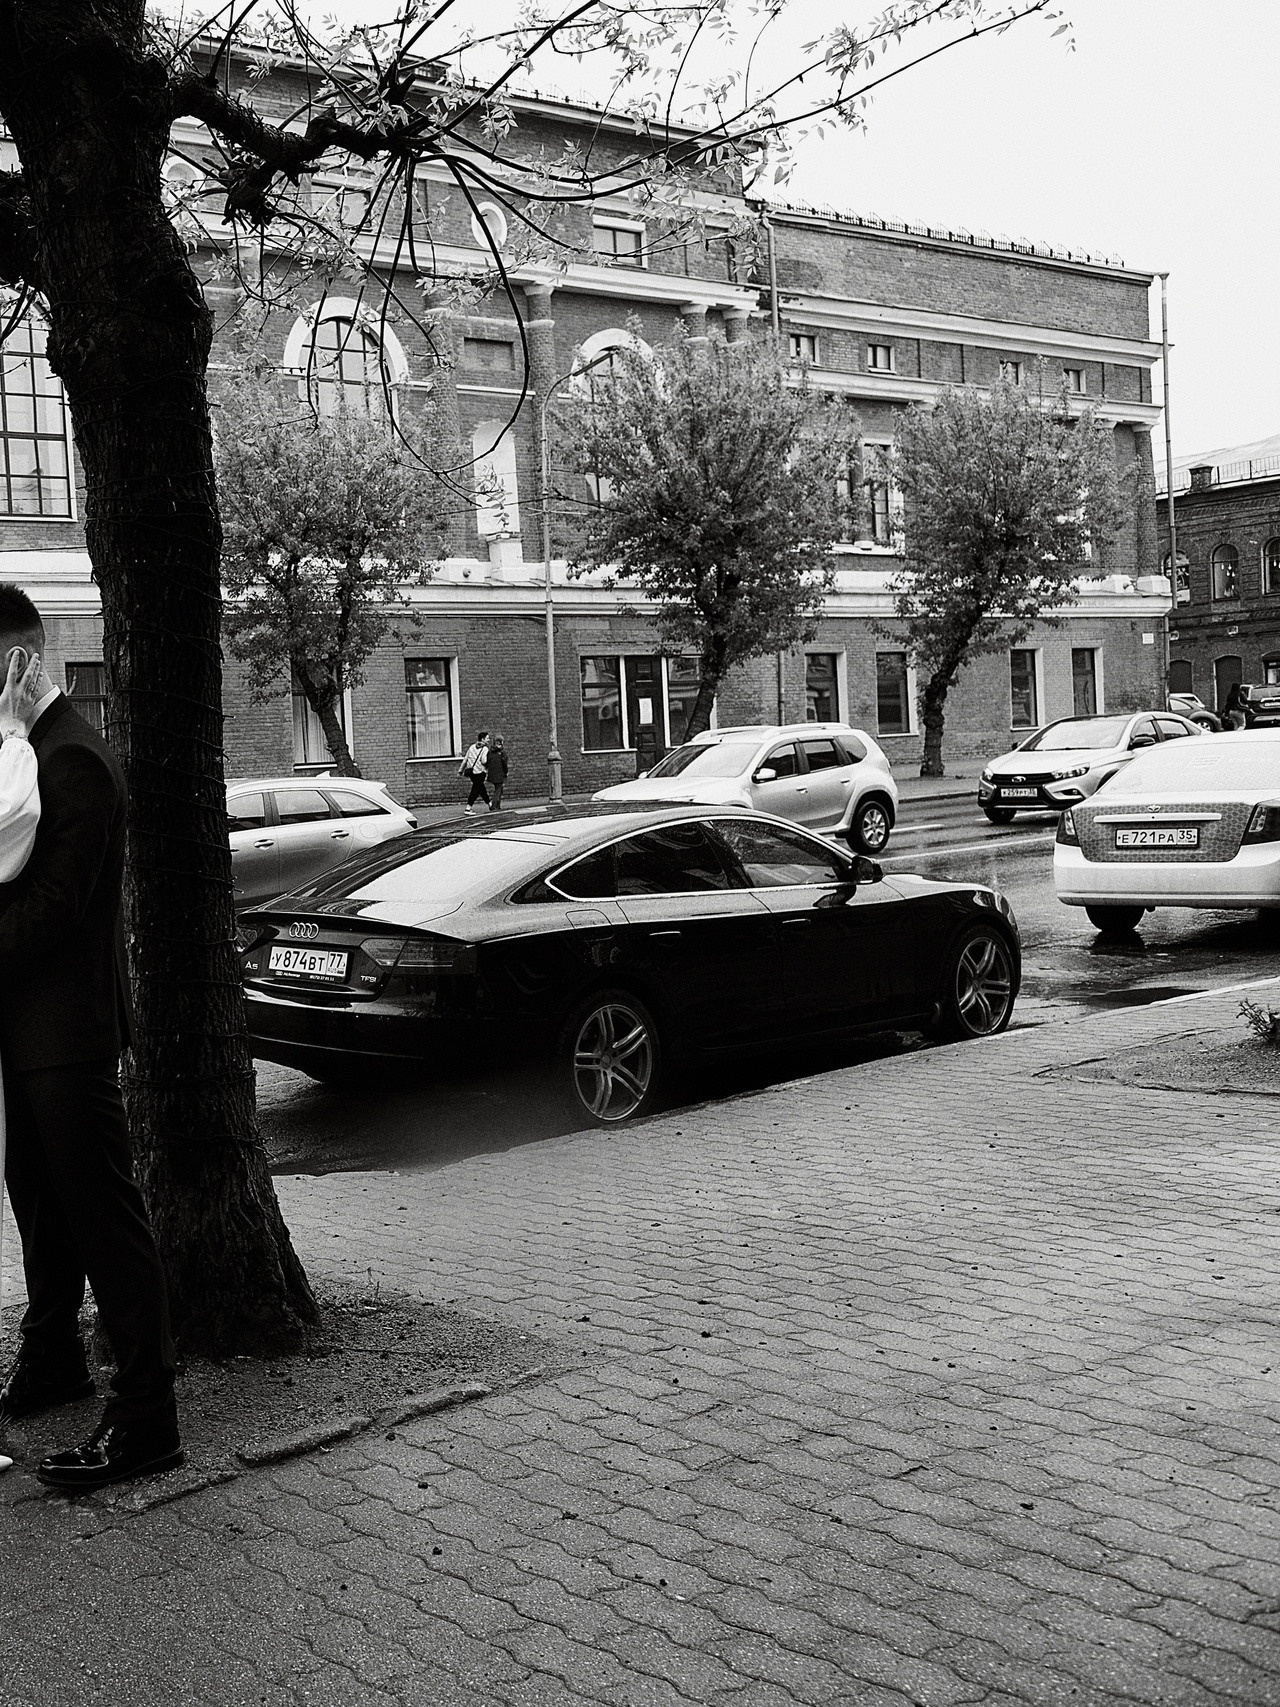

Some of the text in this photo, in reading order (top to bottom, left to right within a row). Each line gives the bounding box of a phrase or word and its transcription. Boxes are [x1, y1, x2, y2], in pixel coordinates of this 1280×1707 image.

[1121, 830, 1193, 843] Е721РА 35
[274, 950, 343, 972] У874ВТ 77
